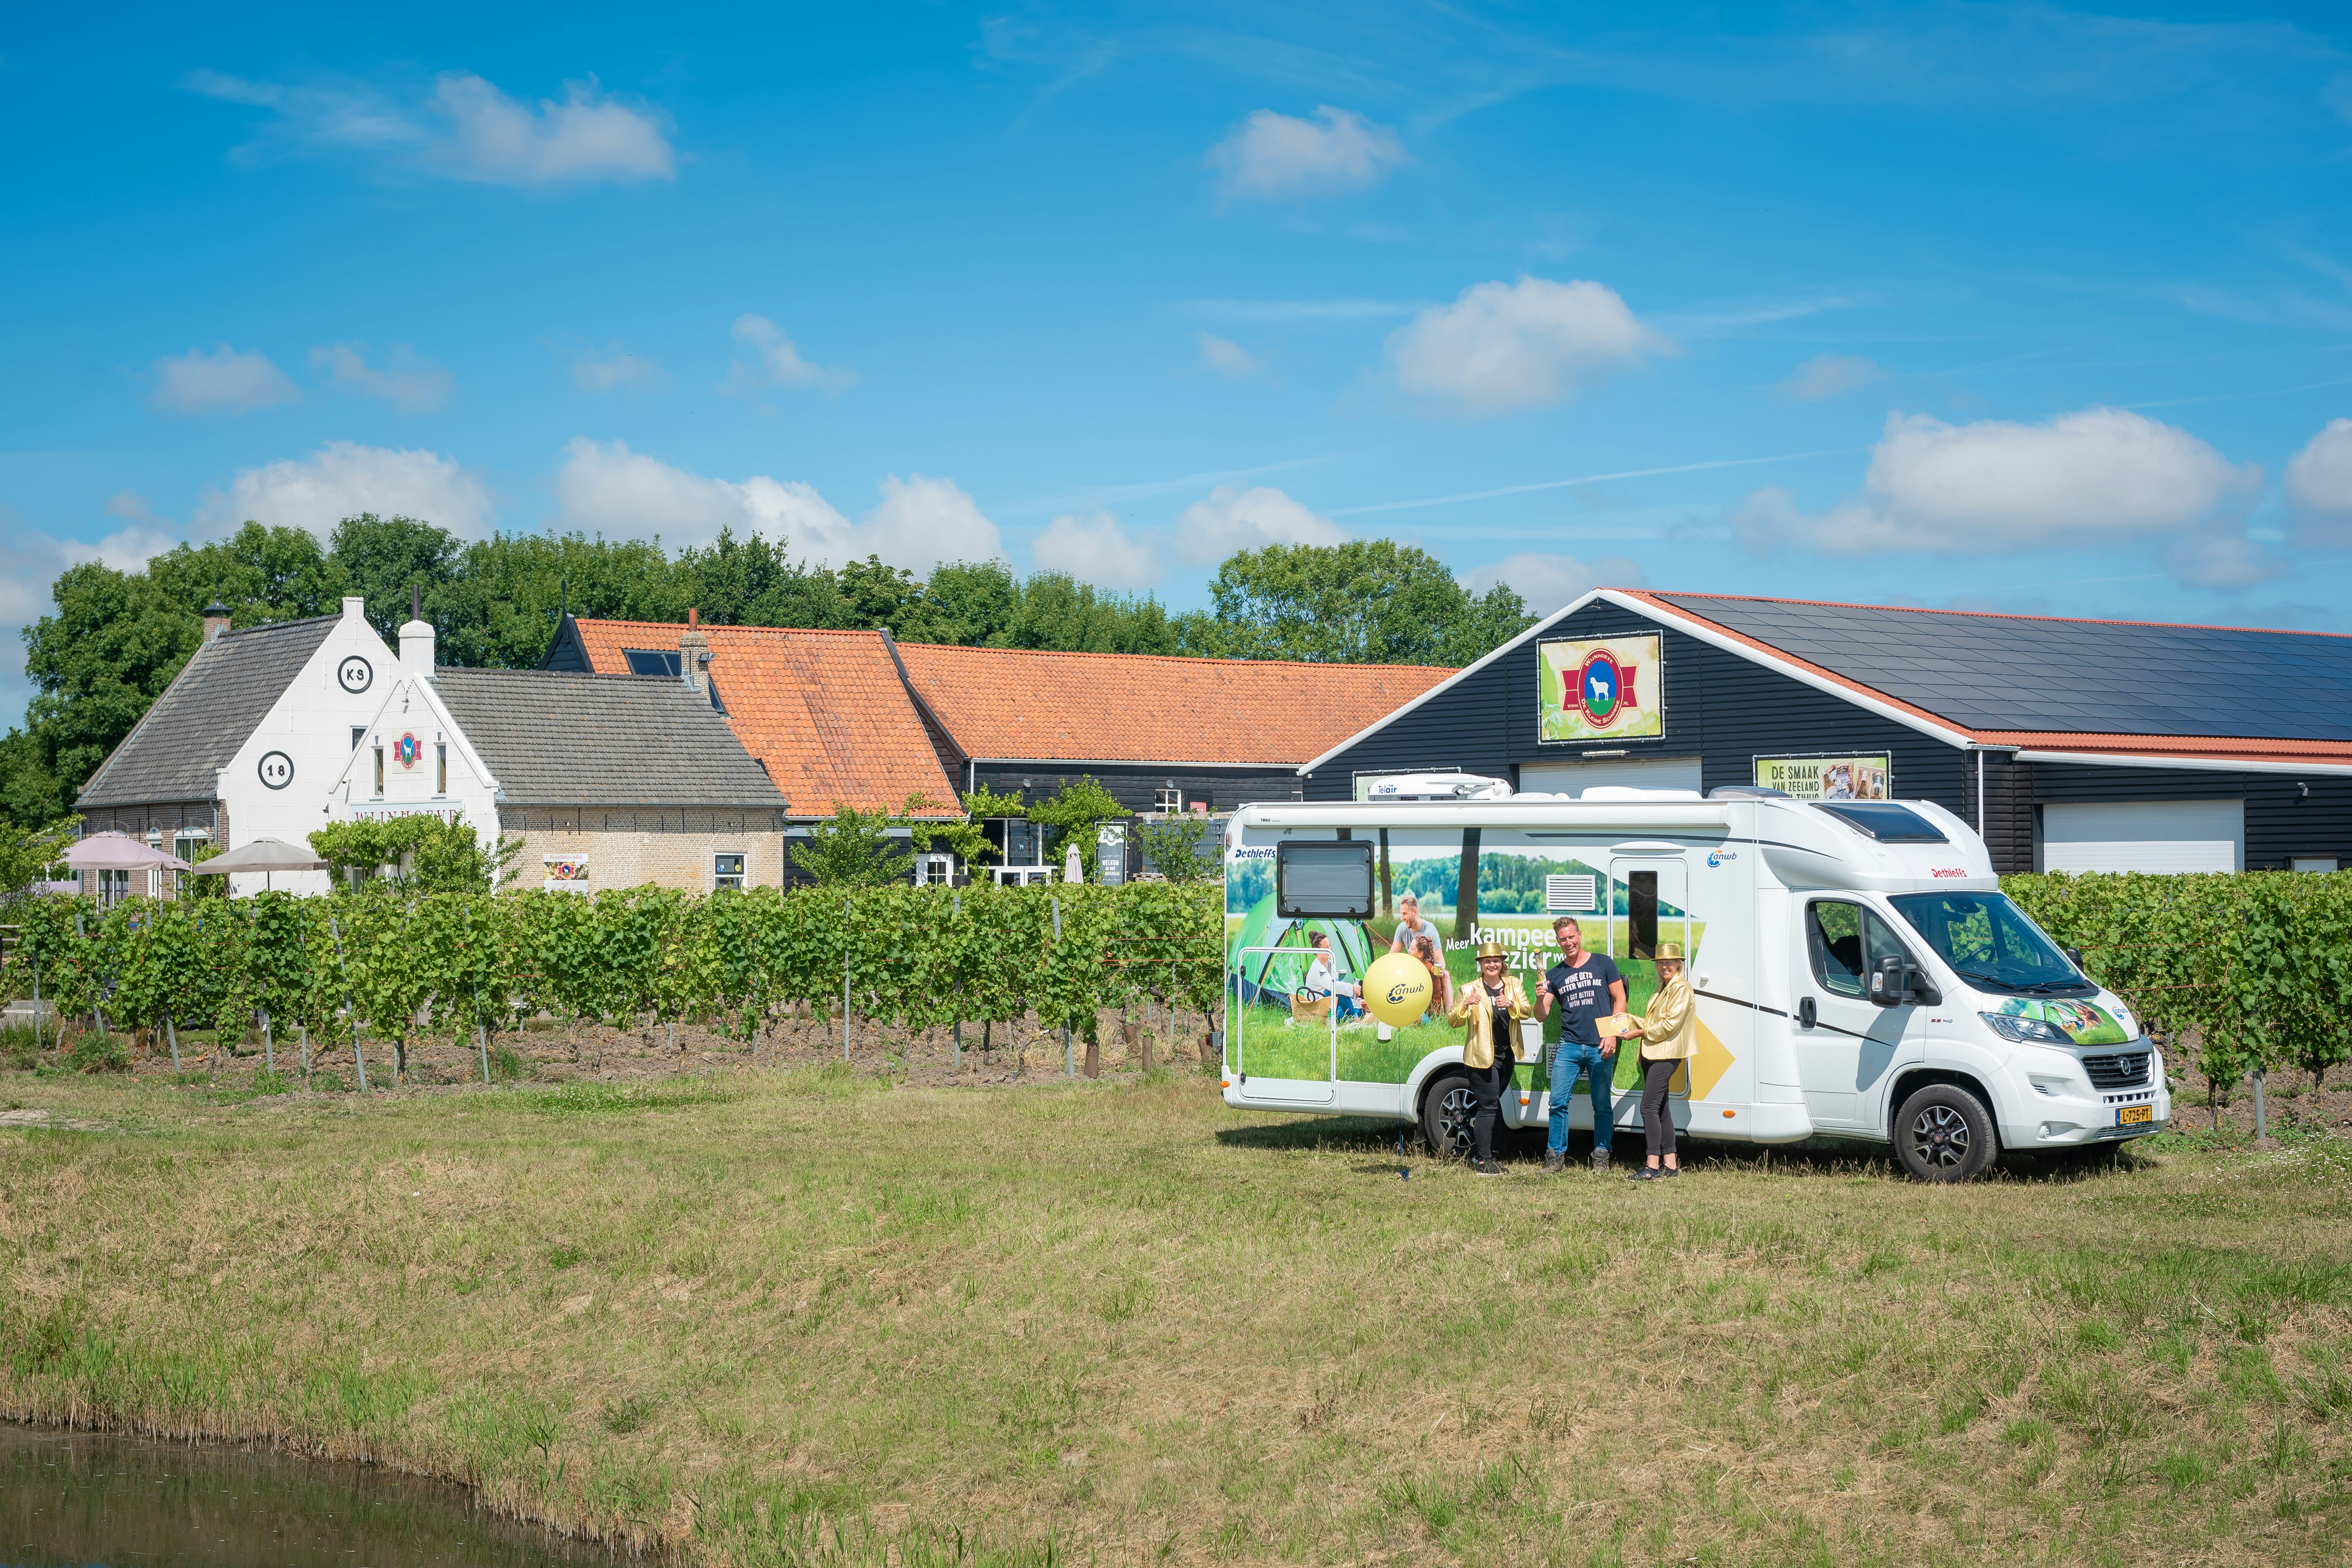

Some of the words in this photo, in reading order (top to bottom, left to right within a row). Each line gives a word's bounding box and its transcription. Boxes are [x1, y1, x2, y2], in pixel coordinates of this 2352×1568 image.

[1585, 654, 1613, 666] WIJNHOEVE
[1586, 709, 1602, 724] KLEINE
[1602, 700, 1620, 723] SCHORRE
[1772, 766, 1784, 780] DE
[1788, 766, 1819, 780] SMAAK
[1772, 782, 1785, 792] VAN
[1788, 781, 1819, 791] ZEELAND
[1235, 849, 1276, 858] Dethleffs
[1931, 868, 1967, 878] Dethleffs
[1445, 938, 1469, 952] Meer
[1470, 922, 1561, 950] kampee
[1565, 973, 1578, 985] WINE
[1579, 972, 1593, 981] GETS
[1395, 983, 1424, 995] anwb
[1558, 983, 1576, 995] BETTER
[1577, 979, 1591, 988] WITH
[1569, 1000, 1580, 1008] WITH
[2123, 1108, 2149, 1122] L-725-PT
